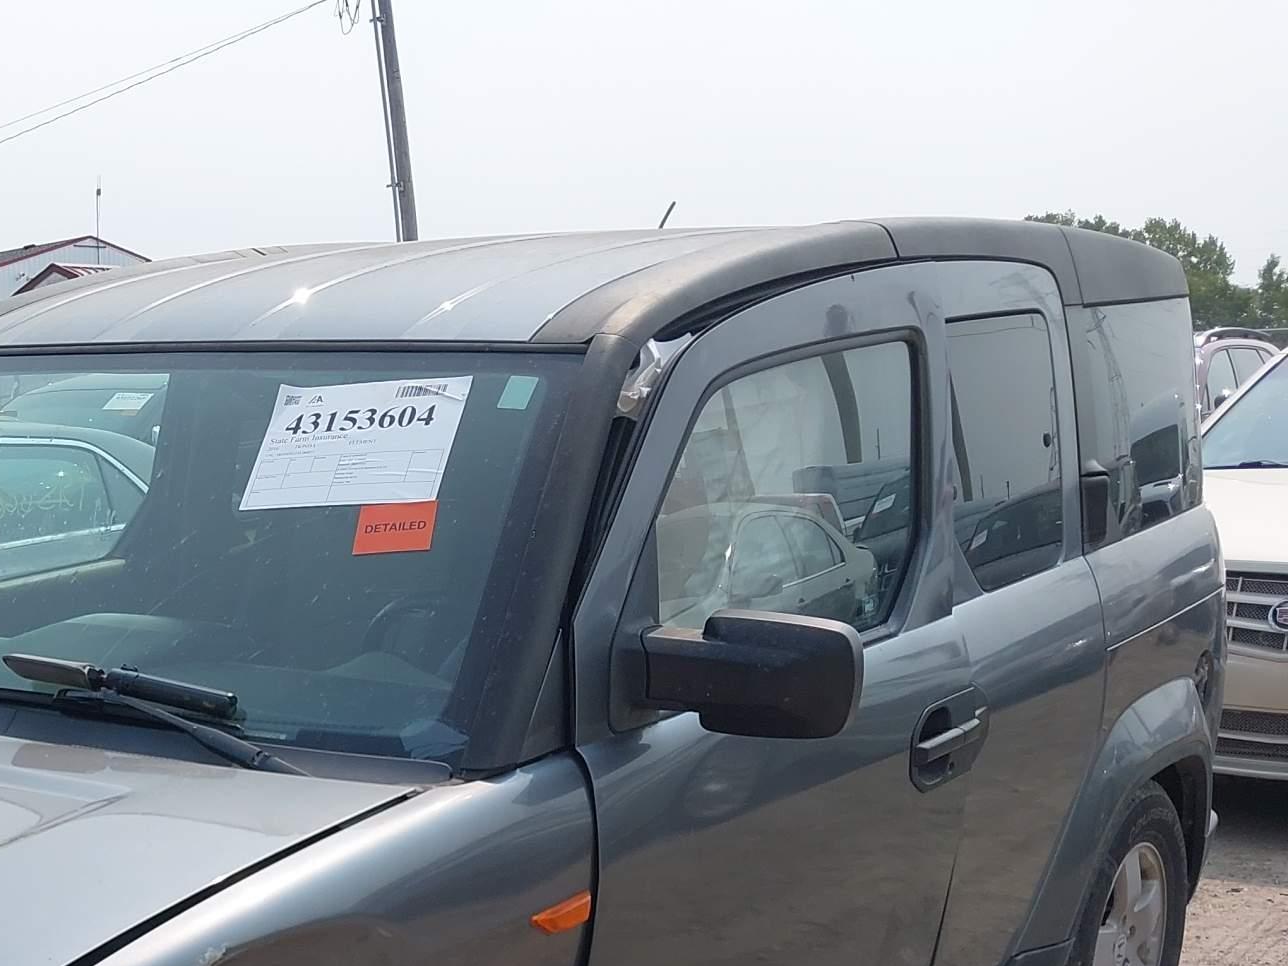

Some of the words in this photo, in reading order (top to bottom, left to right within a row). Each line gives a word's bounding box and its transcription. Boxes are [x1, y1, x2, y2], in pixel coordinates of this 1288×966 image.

[285, 404, 437, 435] 43153604
[270, 437, 289, 445] State
[290, 435, 310, 443] Farm
[364, 520, 427, 534] DETAILED
